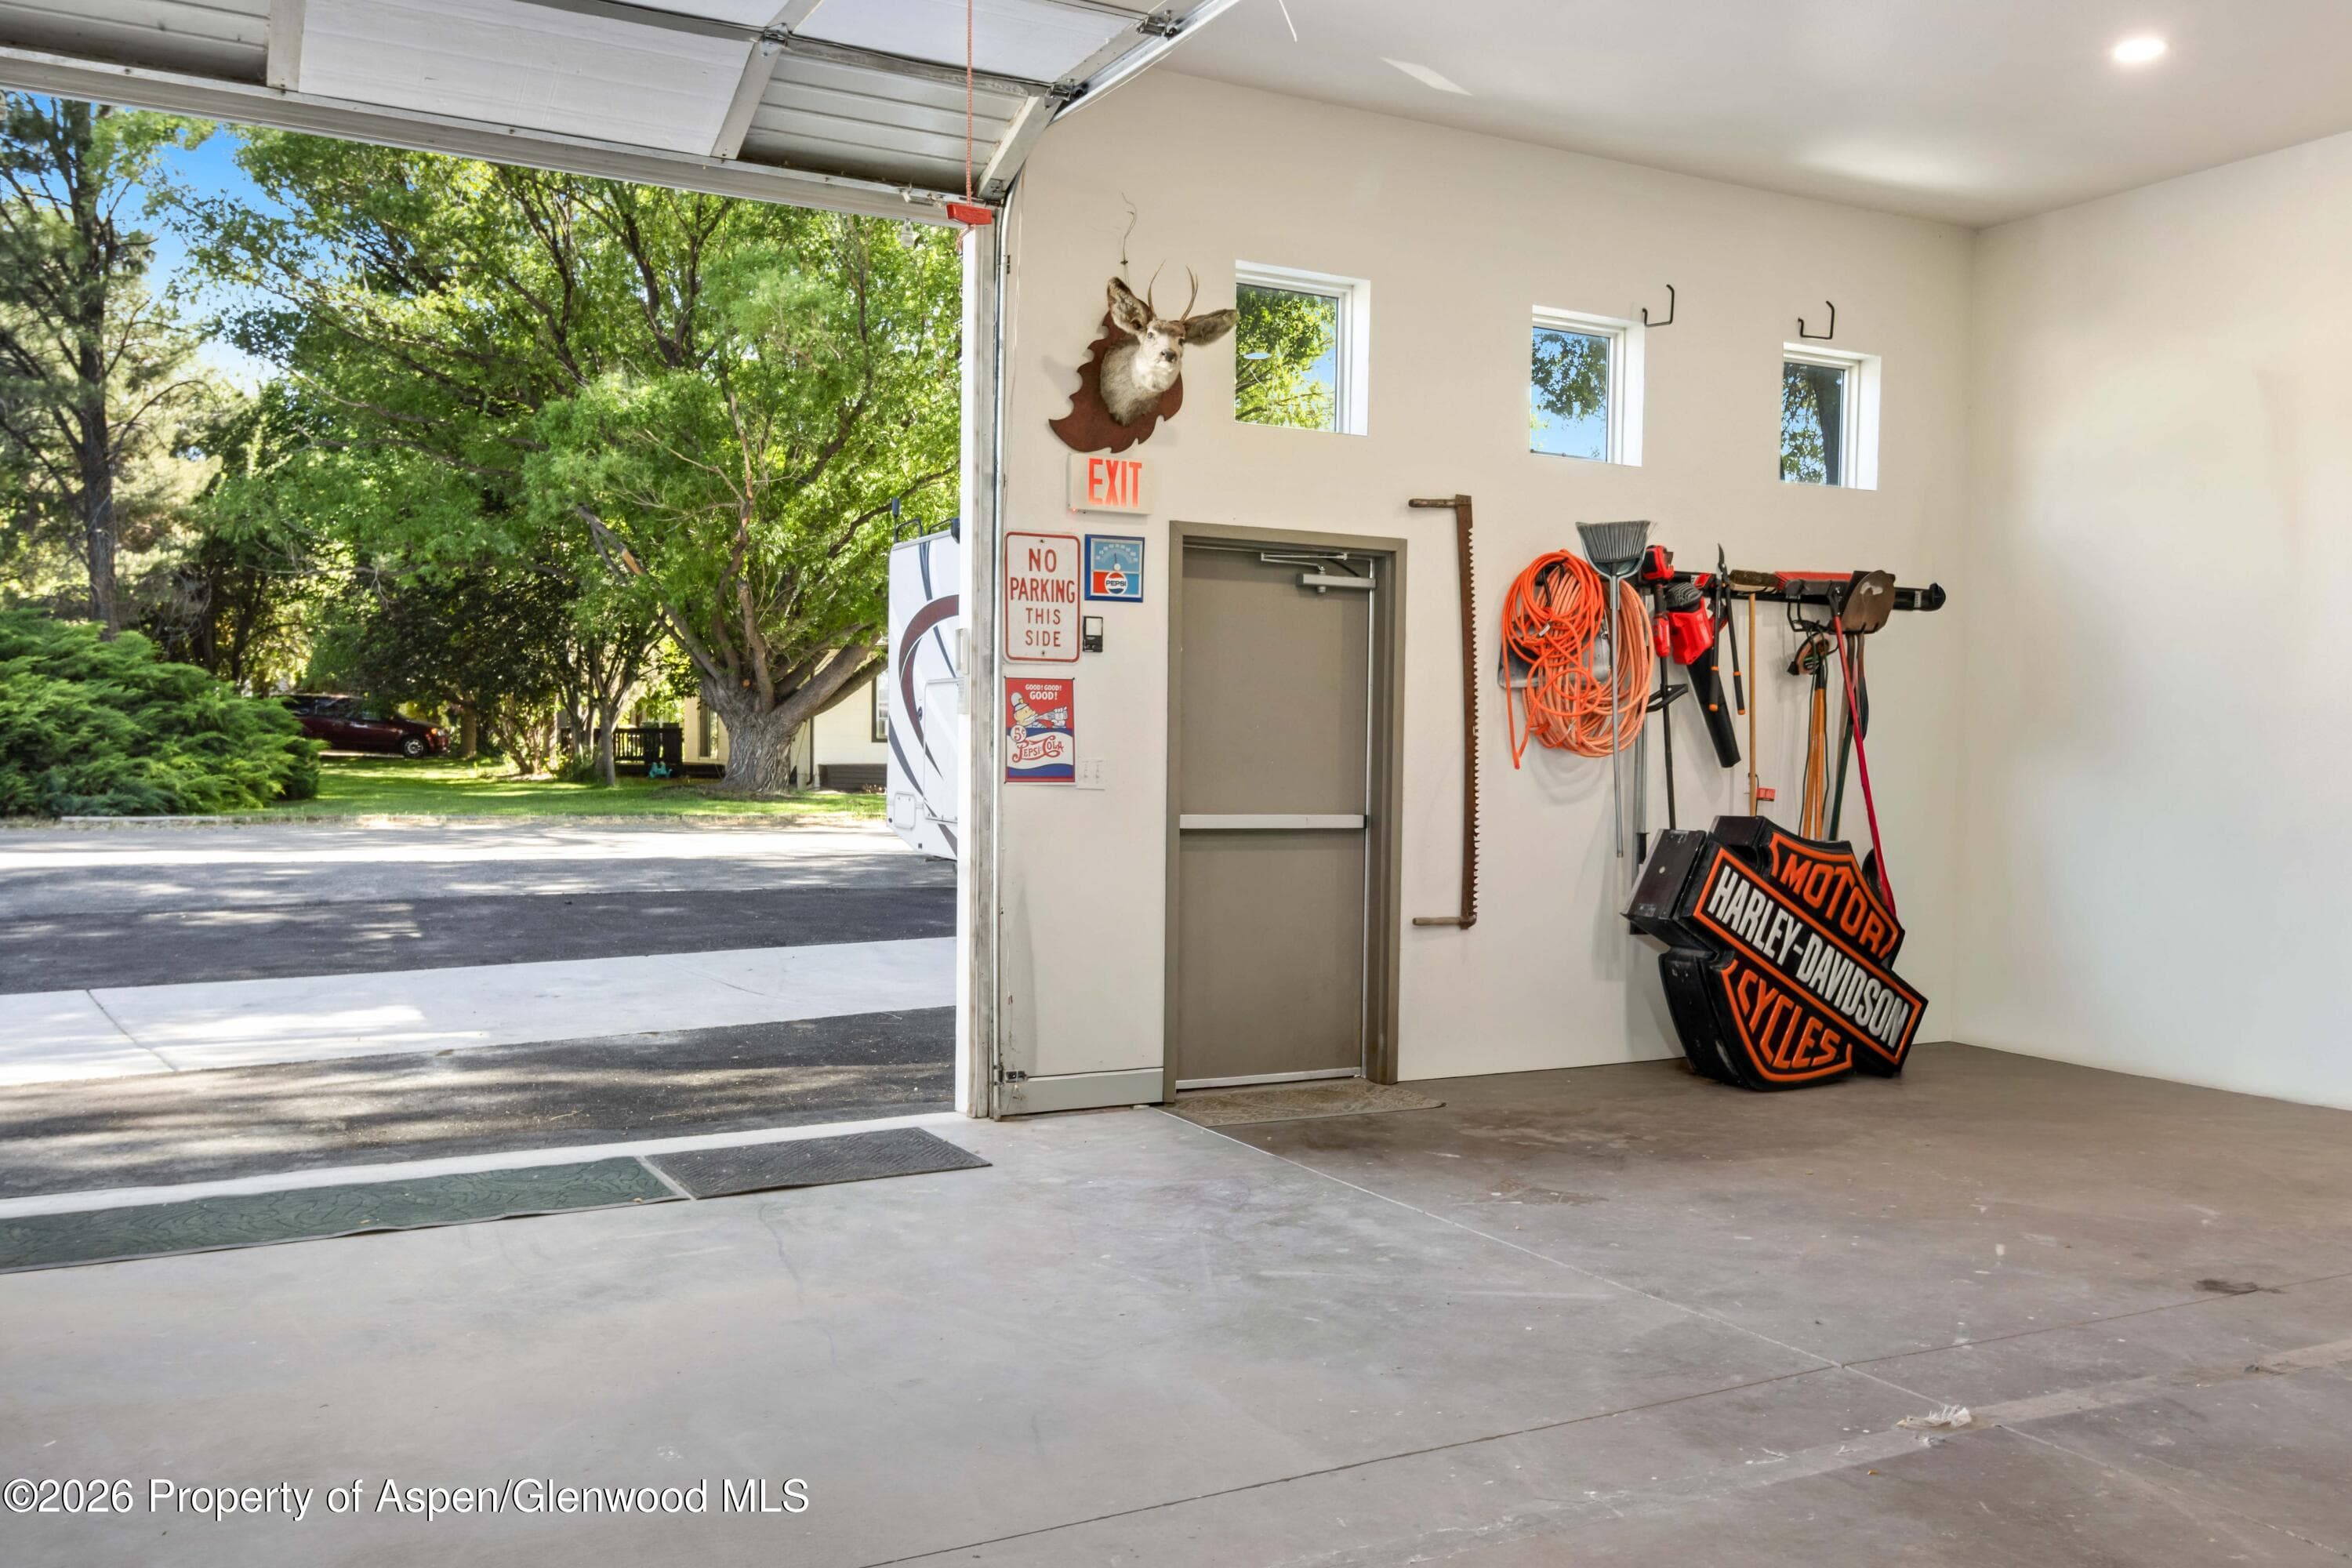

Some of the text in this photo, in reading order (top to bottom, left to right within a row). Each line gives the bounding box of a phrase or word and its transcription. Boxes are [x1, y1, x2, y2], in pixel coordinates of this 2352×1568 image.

[1088, 458, 1142, 507] EXIT
[1029, 548, 1057, 572] NO
[1010, 577, 1076, 604] PARKING
[1025, 608, 1062, 625] THIS
[1025, 630, 1062, 647] SIDE
[1029, 691, 1058, 700] GOOD!
[1781, 854, 1886, 954] MOTOR
[1707, 866, 1909, 1048] HARLEY-DAVIDSON
[1737, 968, 1841, 1069] CYCLES
